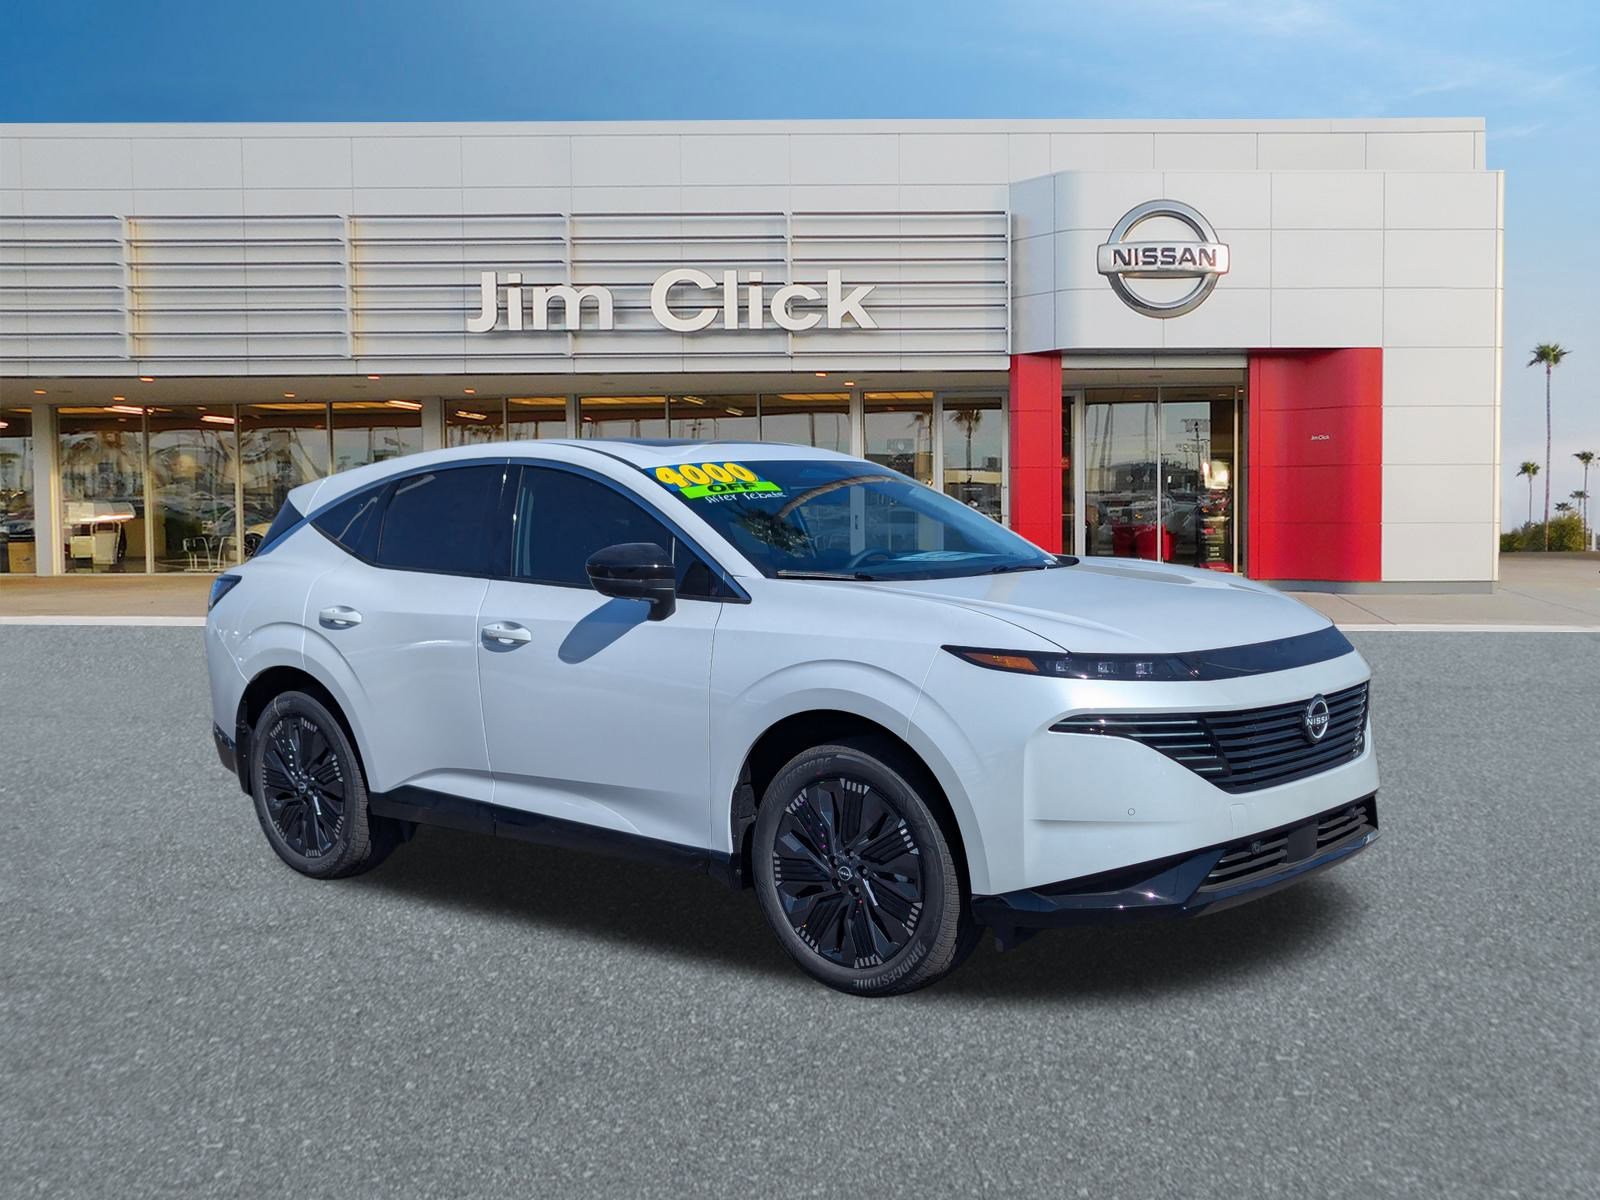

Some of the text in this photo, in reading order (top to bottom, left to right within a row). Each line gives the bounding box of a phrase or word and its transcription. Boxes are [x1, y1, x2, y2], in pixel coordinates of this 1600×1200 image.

[1112, 247, 1217, 267] NISSAN
[467, 268, 879, 333] Jim Click
[655, 462, 759, 488] 4000
[707, 482, 758, 493] OFF
[852, 940, 927, 990] BRIDGESTONE
